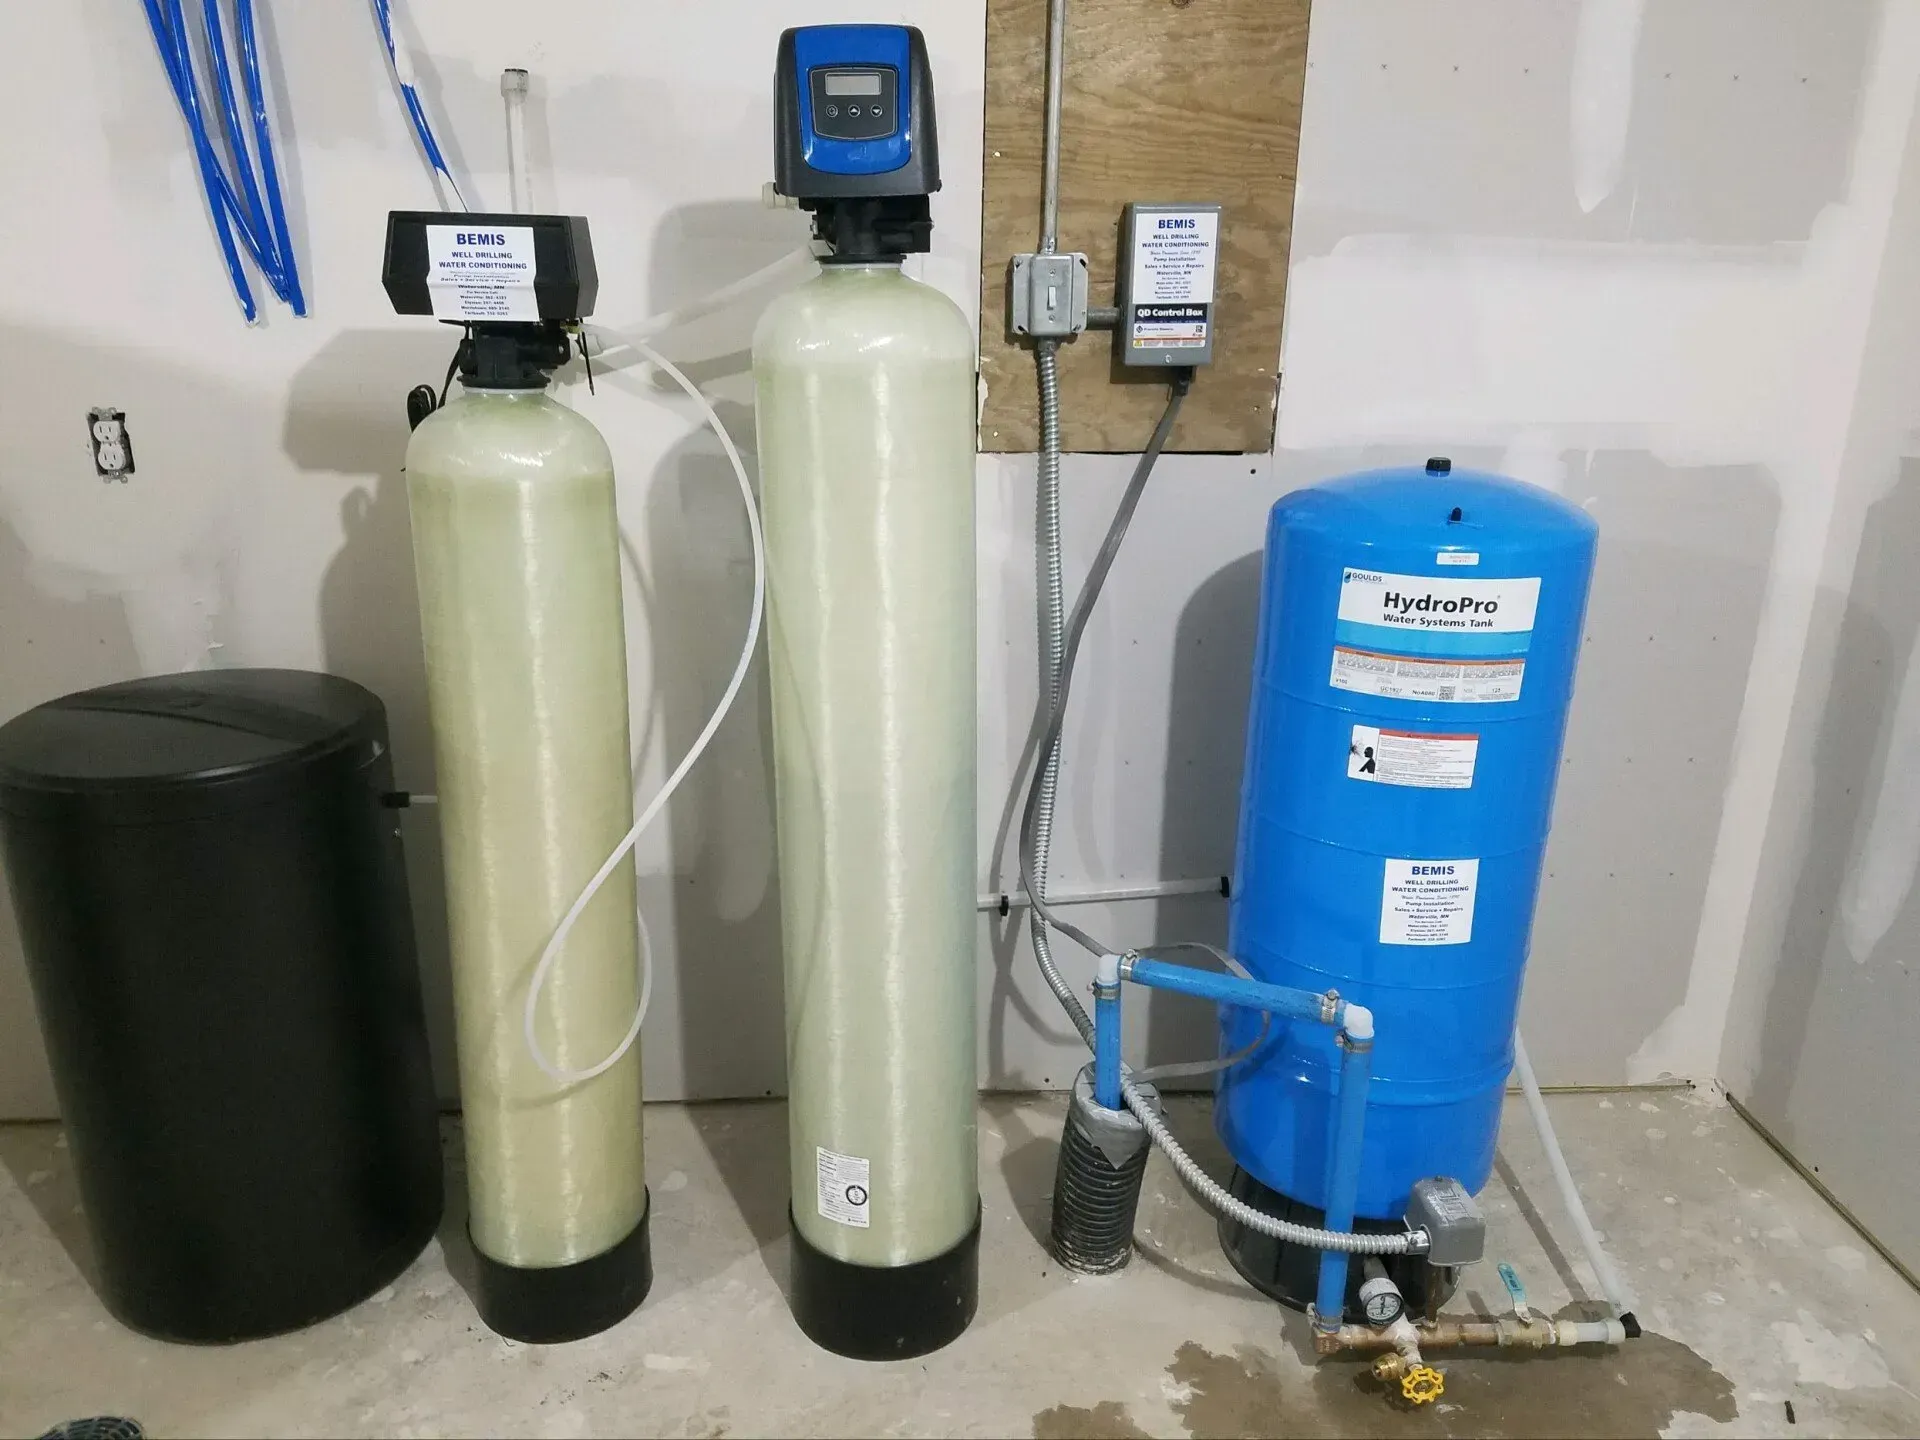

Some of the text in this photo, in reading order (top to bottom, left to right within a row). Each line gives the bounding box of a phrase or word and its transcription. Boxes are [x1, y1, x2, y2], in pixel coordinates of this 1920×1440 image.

[1158, 219, 1196, 229] BEMIS
[456, 233, 506, 246] BEMIS
[451, 251, 475, 259] WELL
[468, 262, 528, 270] CONDITIONING
[1137, 308, 1203, 318] QD Control Box
[1352, 572, 1383, 583] GOULDS
[1383, 591, 1498, 614] HydroPro
[1383, 613, 1494, 628] Water Systems Tank
[1411, 865, 1455, 875] BEMIS
[1418, 885, 1469, 893] CONDITIONING
